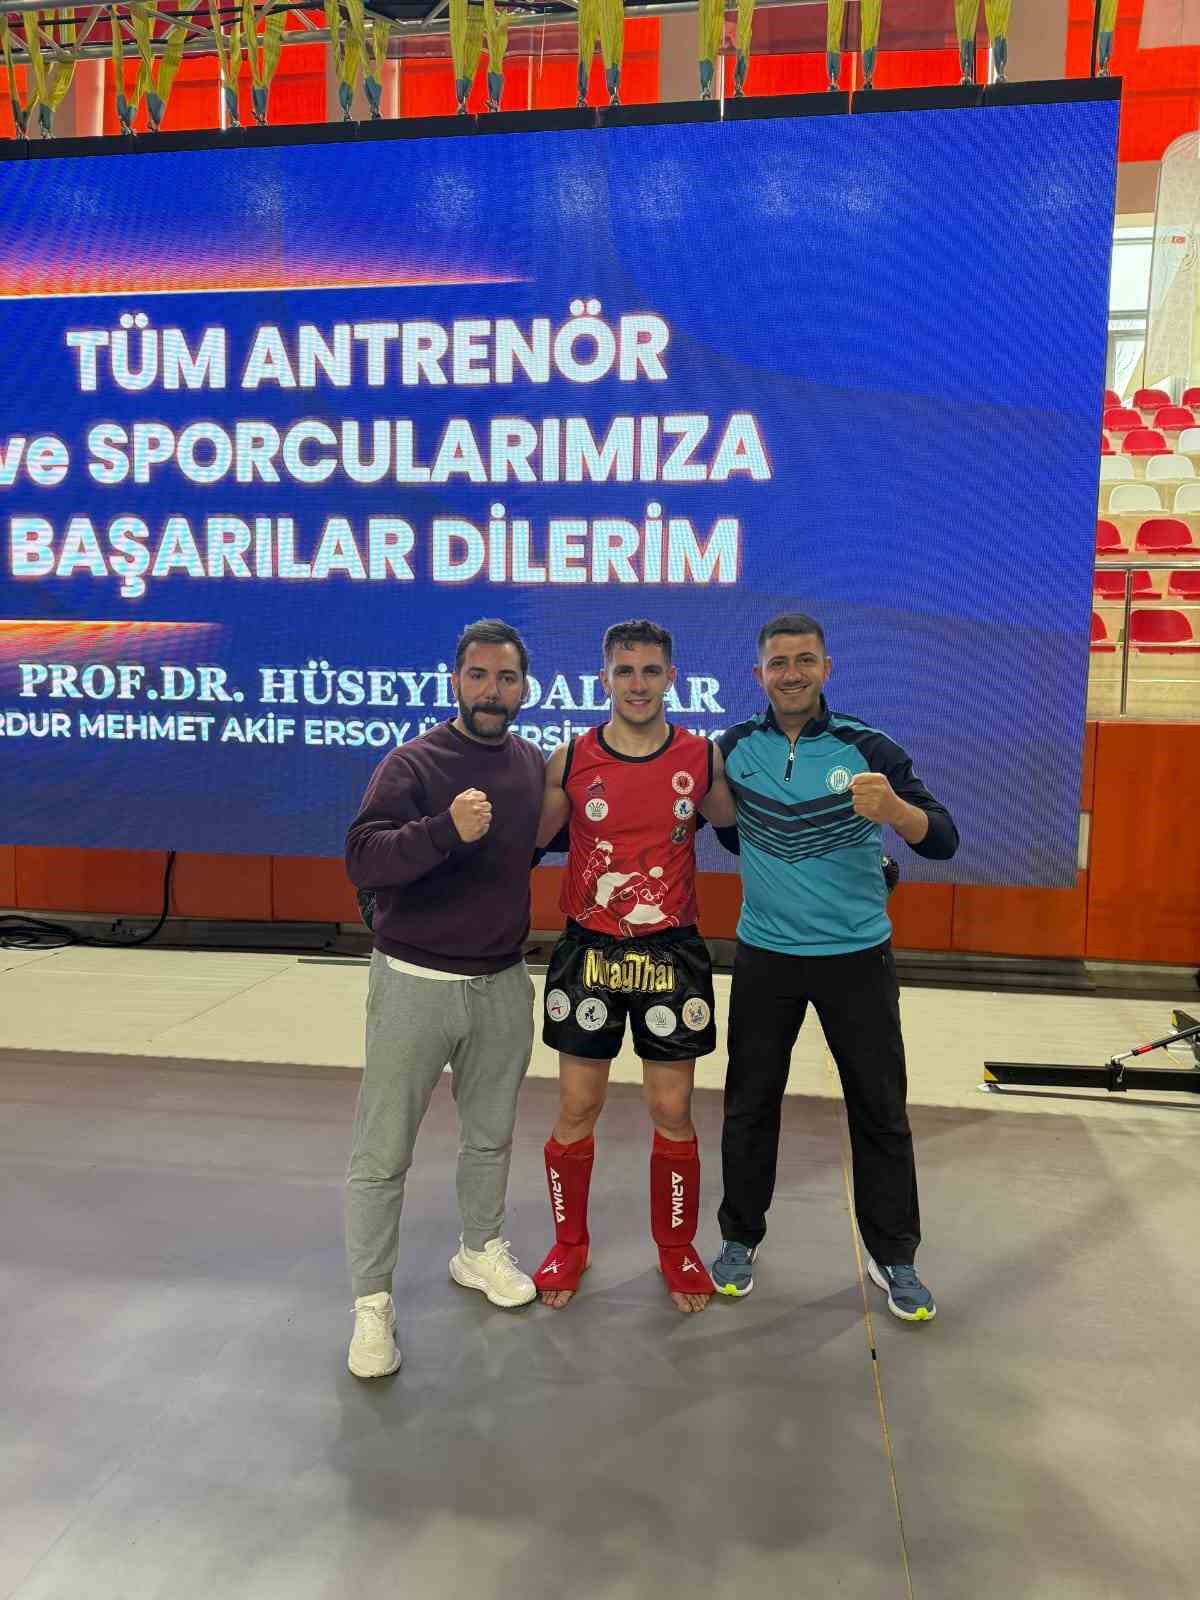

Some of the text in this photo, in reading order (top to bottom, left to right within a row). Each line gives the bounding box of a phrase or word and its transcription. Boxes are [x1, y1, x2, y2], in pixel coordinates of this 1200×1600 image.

[66, 299, 670, 391] TÜM ANTRENÖR
[88, 414, 771, 484] SPORCULARIMIZA
[11, 502, 738, 598] BAŞARILAR DİLERİM
[19, 660, 725, 712] PROF.DR. HÜSEYİ DALAR
[0, 712, 72, 738] DUR
[80, 713, 215, 742] MEHMET
[221, 713, 296, 743] AKİF
[304, 719, 411, 748] ERSOY
[550, 1167, 566, 1224] ARIMA
[671, 1171, 684, 1229] ARIMA
